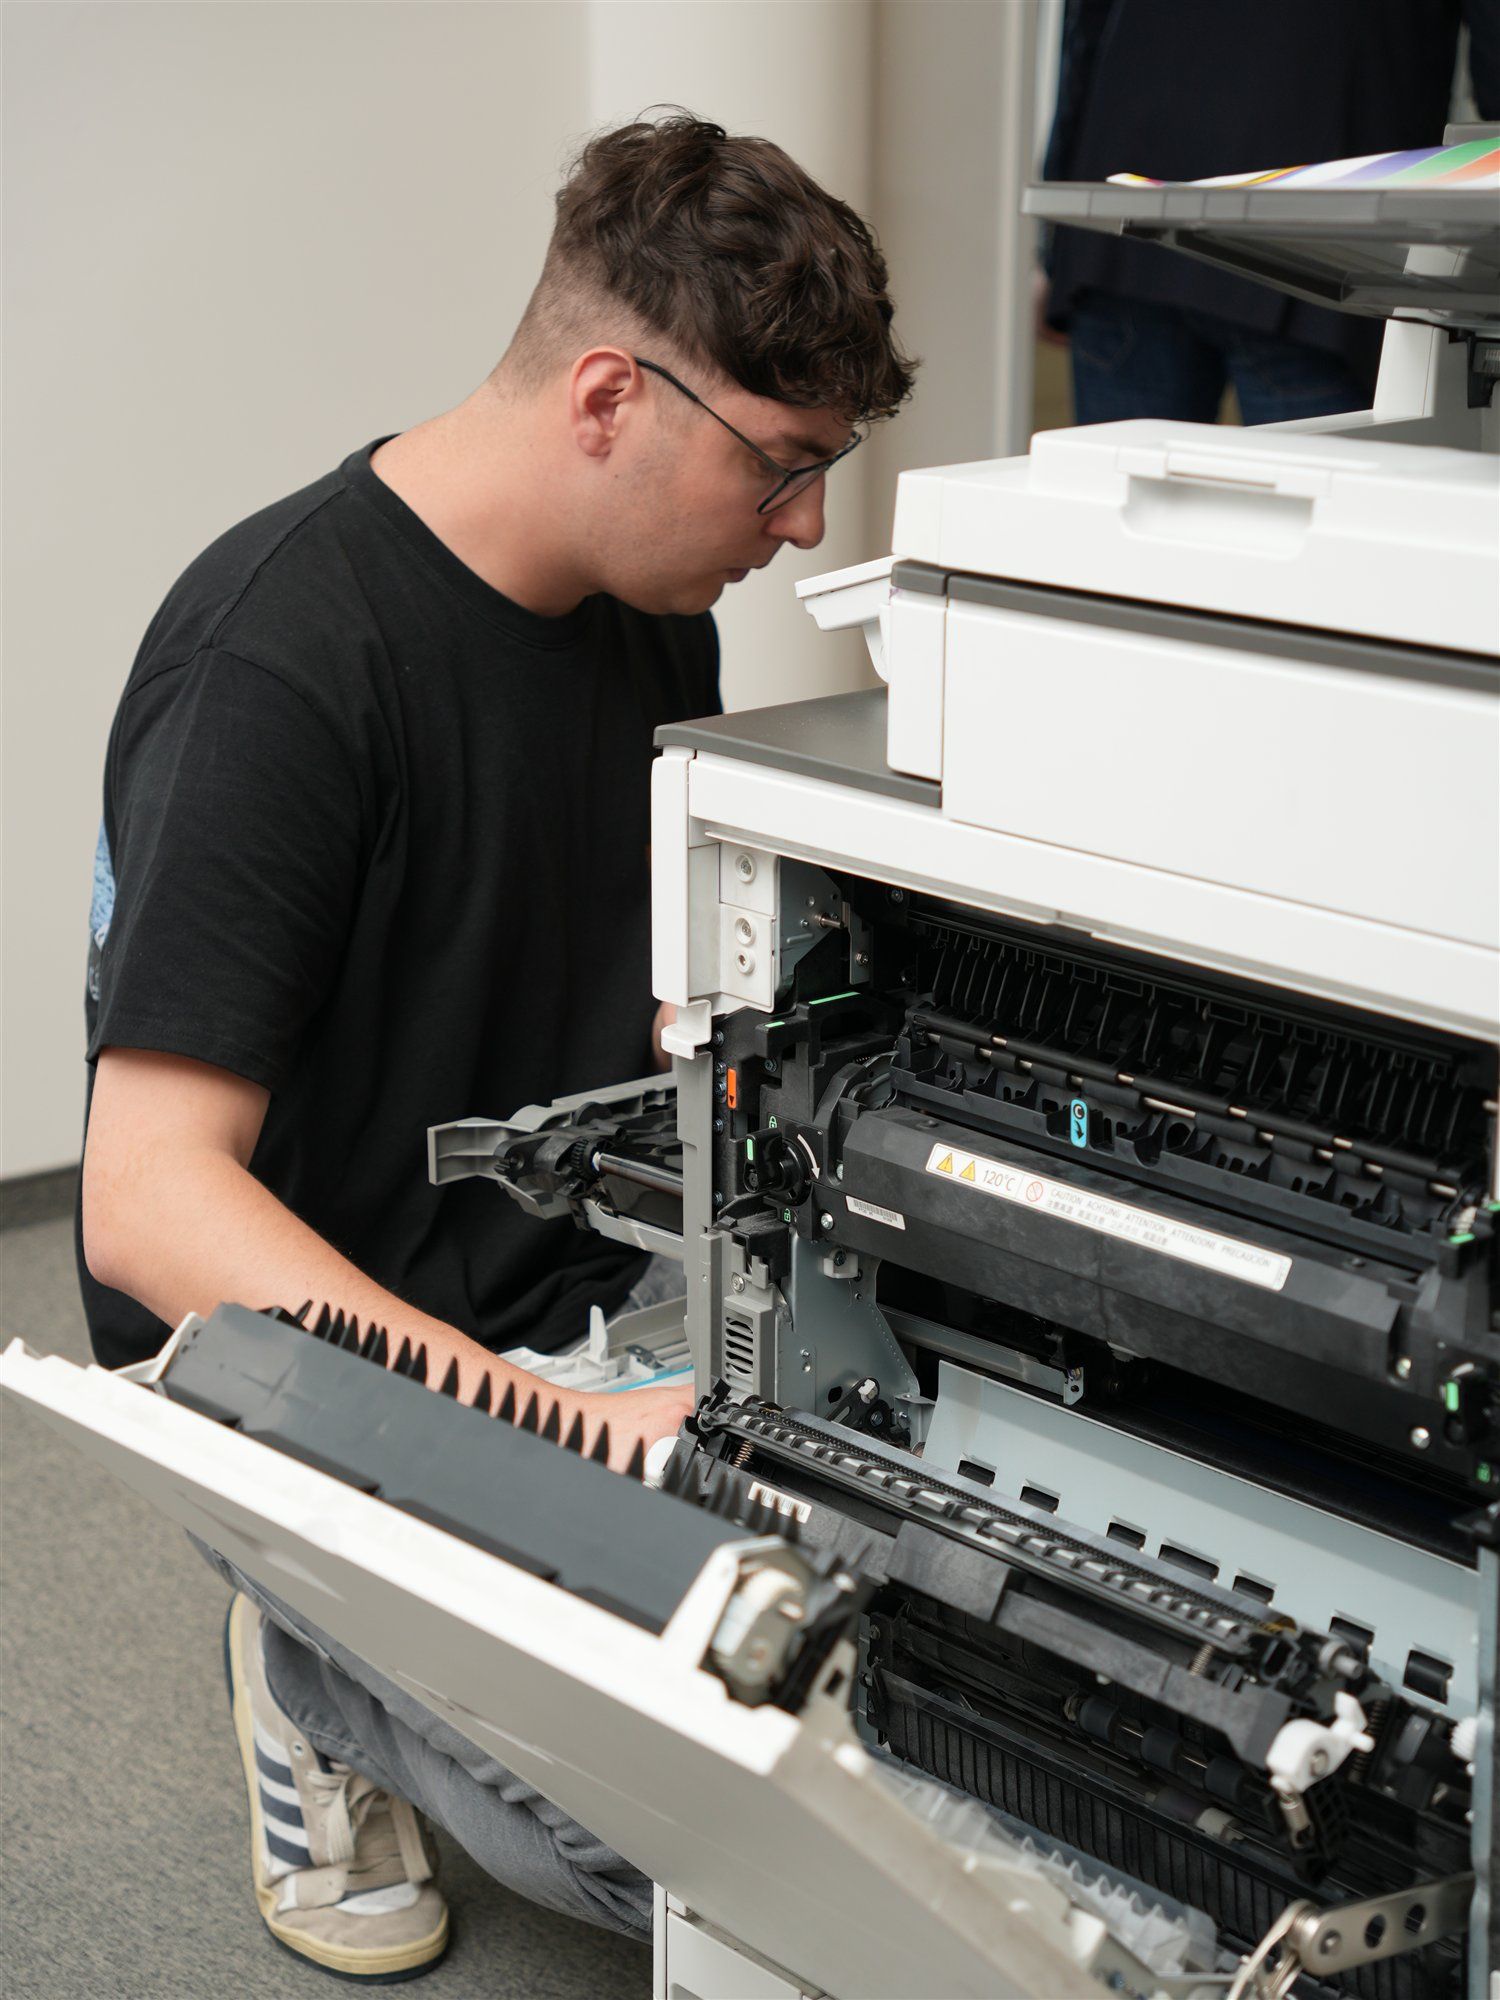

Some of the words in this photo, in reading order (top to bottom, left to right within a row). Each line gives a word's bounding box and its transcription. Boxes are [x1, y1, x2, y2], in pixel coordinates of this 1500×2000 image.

[983, 1170, 1015, 1191] 120°C
[1051, 1188, 1081, 1205] CAUTION
[1087, 1200, 1120, 1218] ACHTUNG
[1126, 1213, 1166, 1233] ATTENTION
[1171, 1229, 1216, 1250] ATTENZIONE
